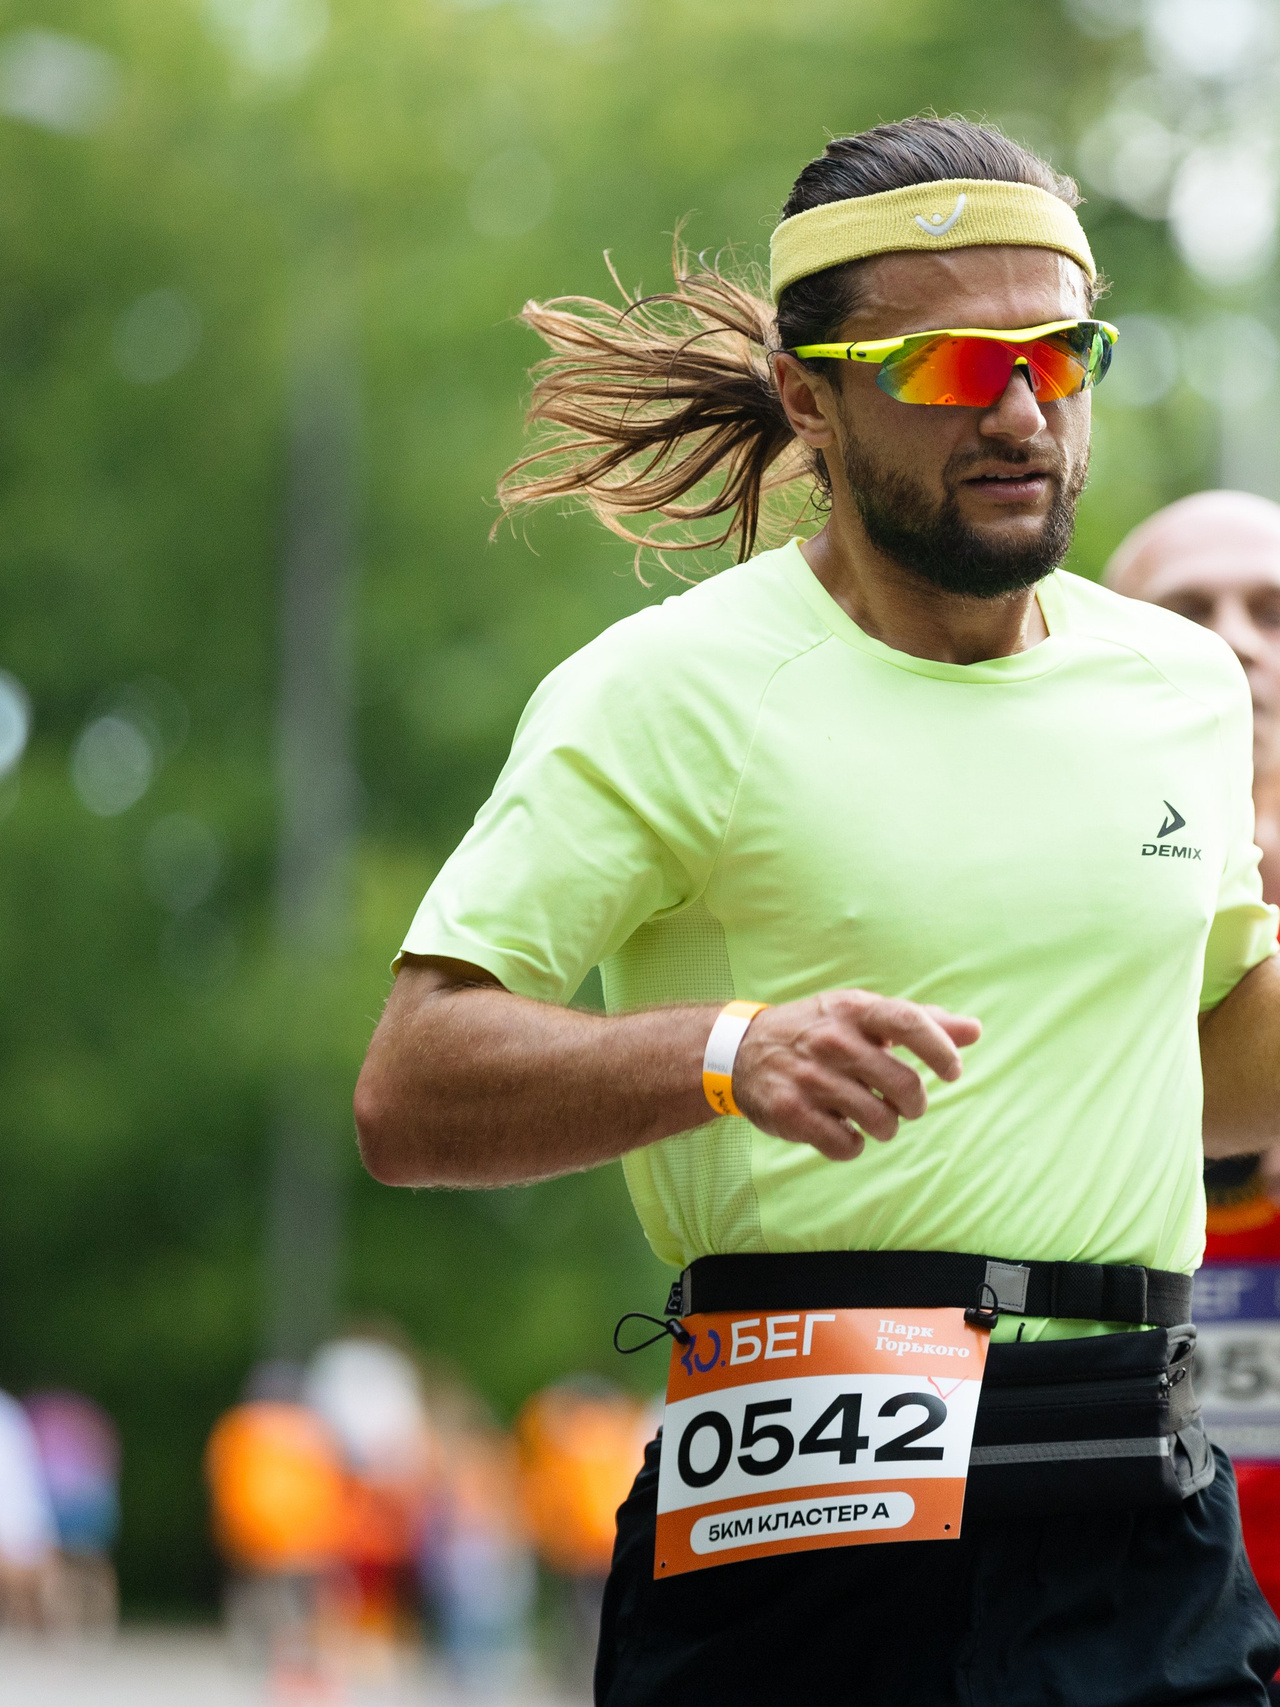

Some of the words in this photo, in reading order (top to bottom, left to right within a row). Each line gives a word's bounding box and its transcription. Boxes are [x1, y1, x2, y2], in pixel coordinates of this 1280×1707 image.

[1141, 843, 1202, 861] DEMIX
[877, 1319, 934, 1340] Парк
[875, 1336, 970, 1358] Горького
[677, 1392, 948, 1488] 0542
[708, 1517, 753, 1542] 5КМ
[758, 1503, 868, 1533] КЛАСТЕР
